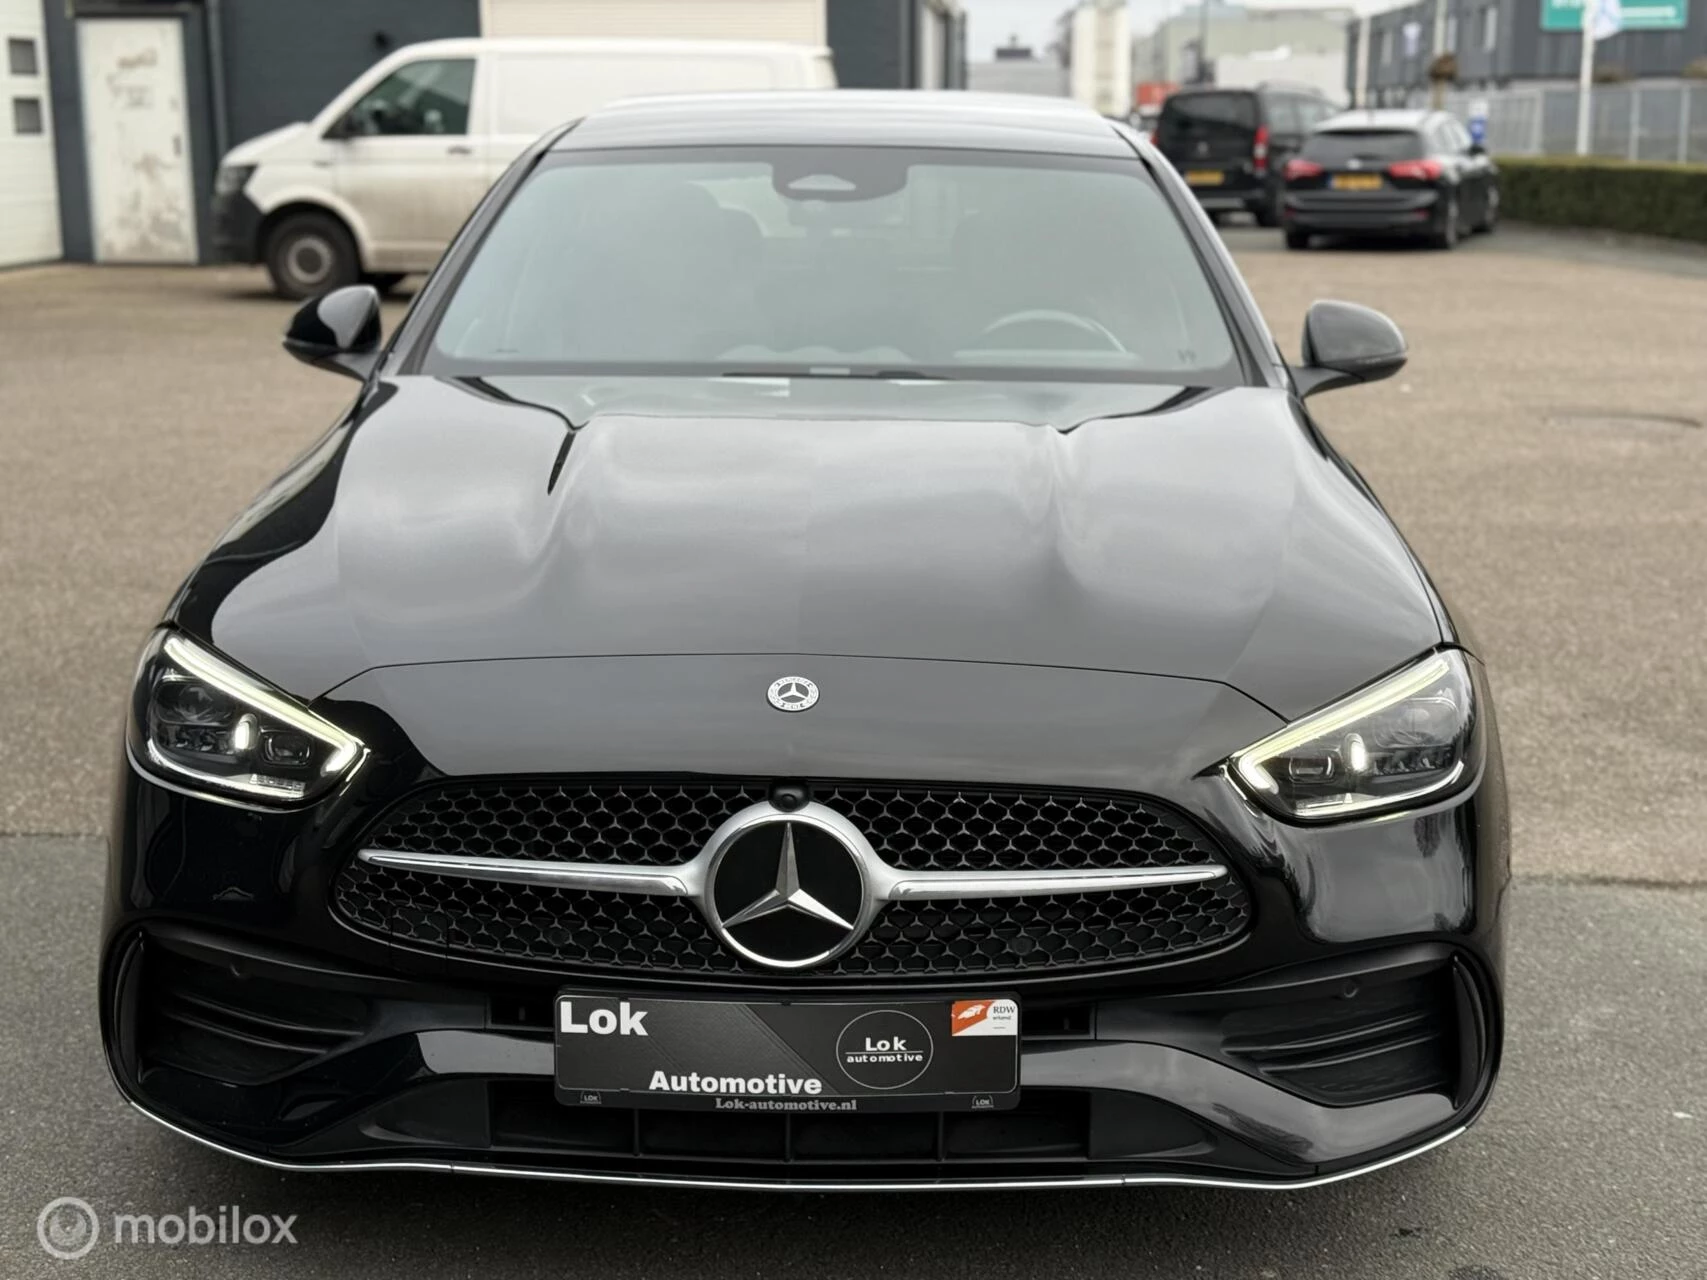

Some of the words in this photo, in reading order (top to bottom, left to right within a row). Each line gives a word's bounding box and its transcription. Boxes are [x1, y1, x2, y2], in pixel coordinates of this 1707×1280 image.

[993, 1006, 1016, 1014] RDW
[560, 1001, 649, 1036] Lok
[865, 1036, 907, 1051] Lok
[847, 1053, 923, 1063] automotive
[649, 1070, 822, 1094] Automotive
[715, 1098, 857, 1110] Lok-automotive.nl
